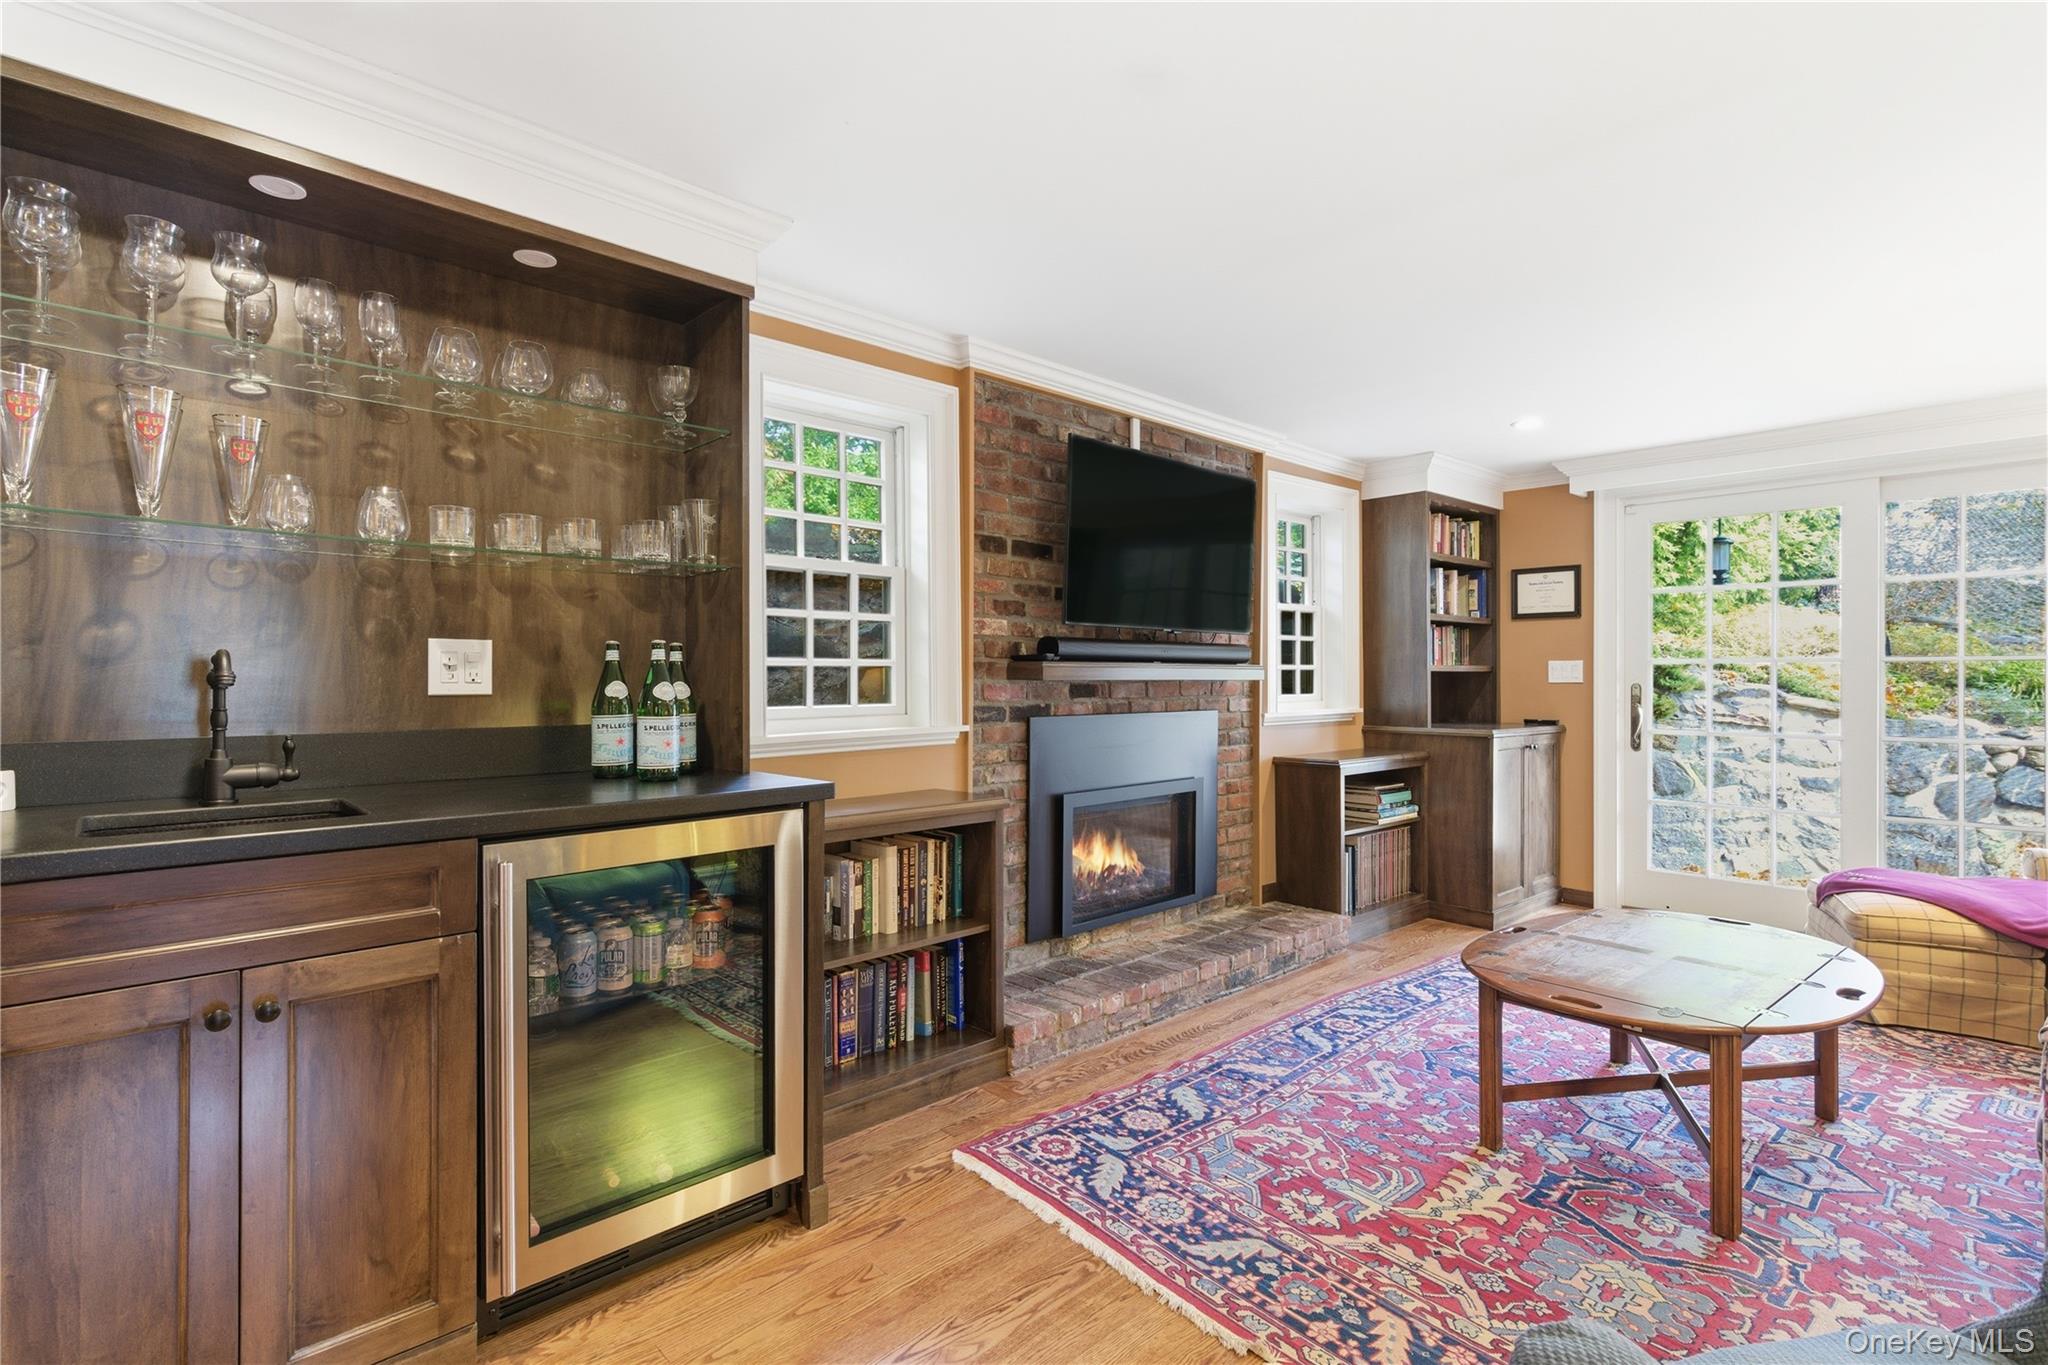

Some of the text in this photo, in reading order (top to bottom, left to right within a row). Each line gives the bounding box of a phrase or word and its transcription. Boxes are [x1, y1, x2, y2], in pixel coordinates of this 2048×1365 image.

[697, 931, 718, 943] POLAR
[600, 951, 624, 963] POLAR
[889, 979, 897, 997] KEN
